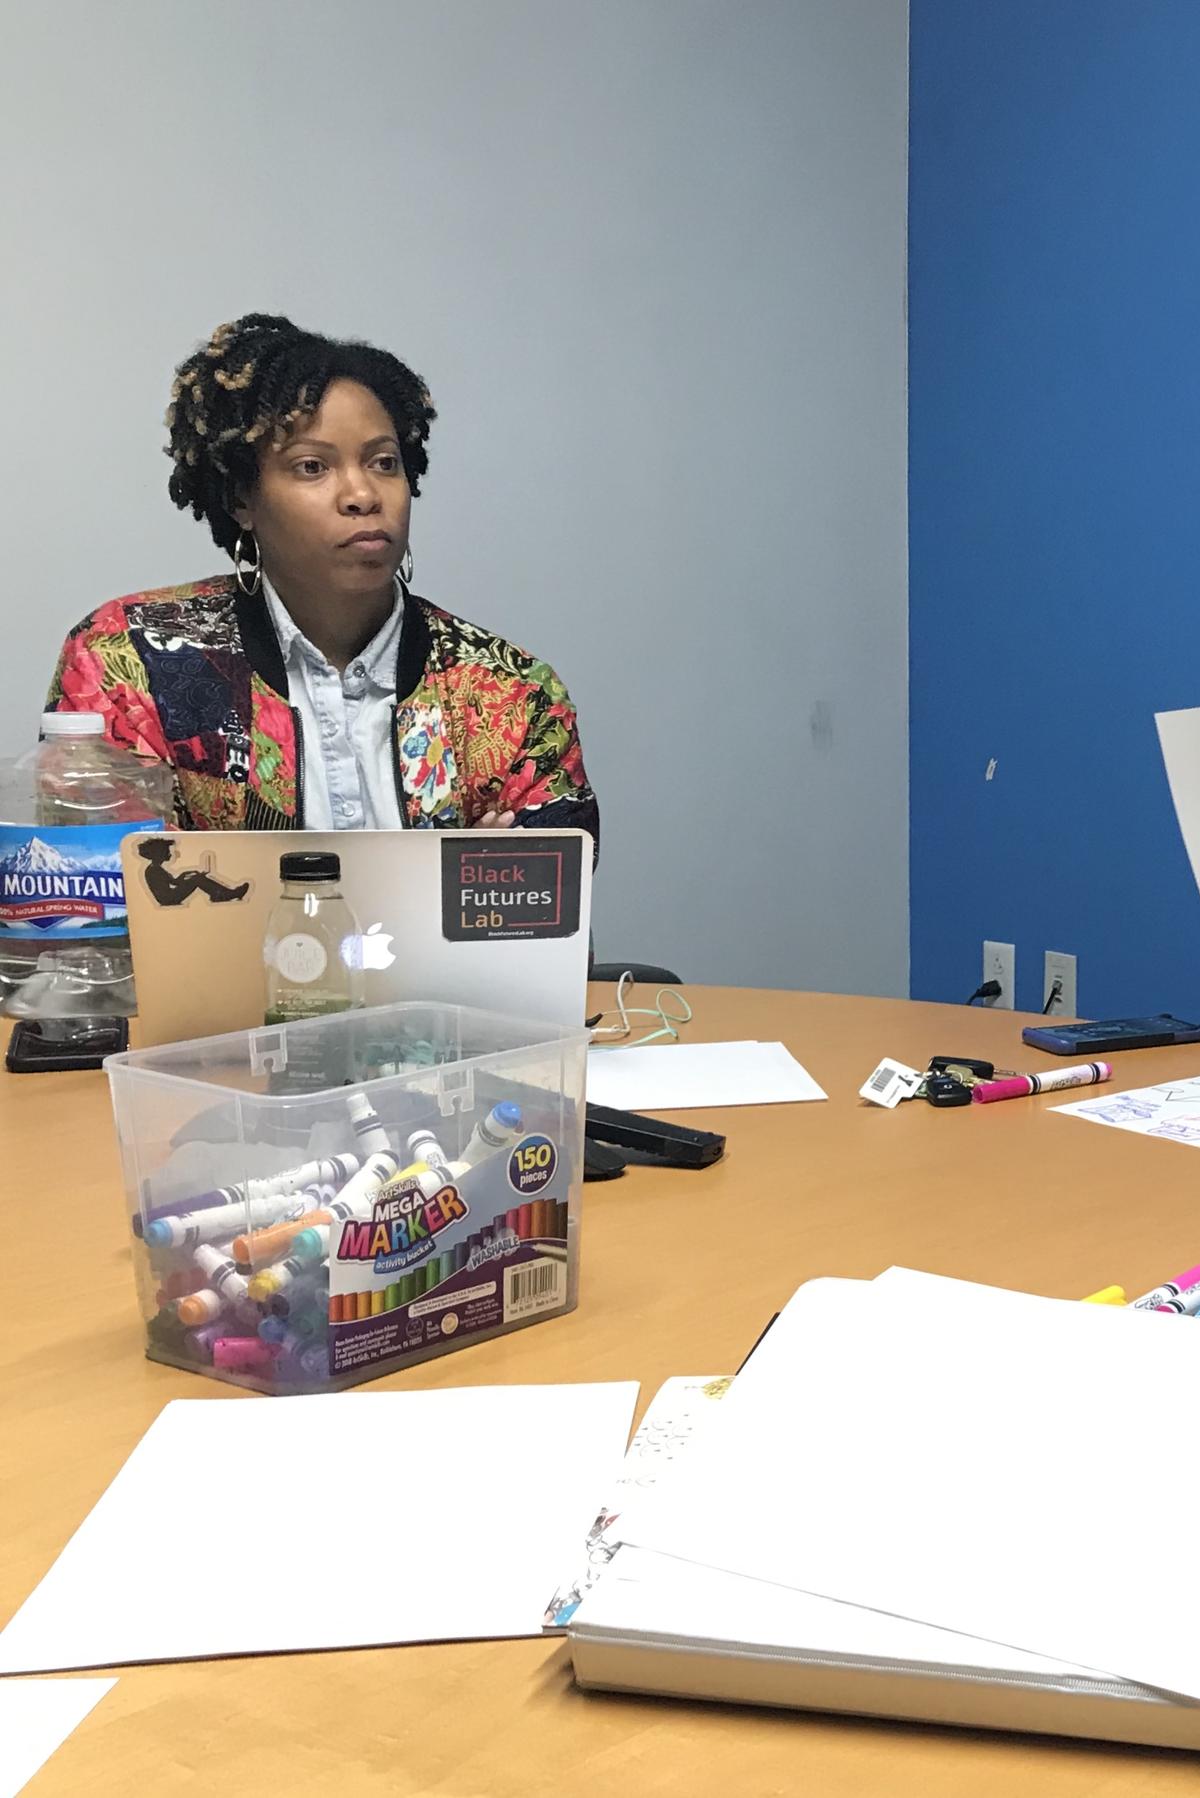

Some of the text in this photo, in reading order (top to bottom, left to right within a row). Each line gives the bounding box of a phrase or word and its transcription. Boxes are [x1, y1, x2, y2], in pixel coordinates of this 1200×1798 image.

[4, 873, 125, 898] MOUNTAIN
[460, 865, 525, 884] Black
[15, 905, 44, 915] NATURAL
[45, 904, 72, 912] SPRING
[73, 904, 98, 914] WATER
[461, 888, 552, 907] Futures
[461, 910, 503, 928] Lab
[514, 1144, 551, 1172] 150
[520, 1169, 548, 1188] pieces
[374, 1191, 425, 1222] MEGA
[339, 1187, 464, 1257] MARKER
[375, 1240, 433, 1269] activity bucket
[471, 1235, 520, 1268] WASHABLE
